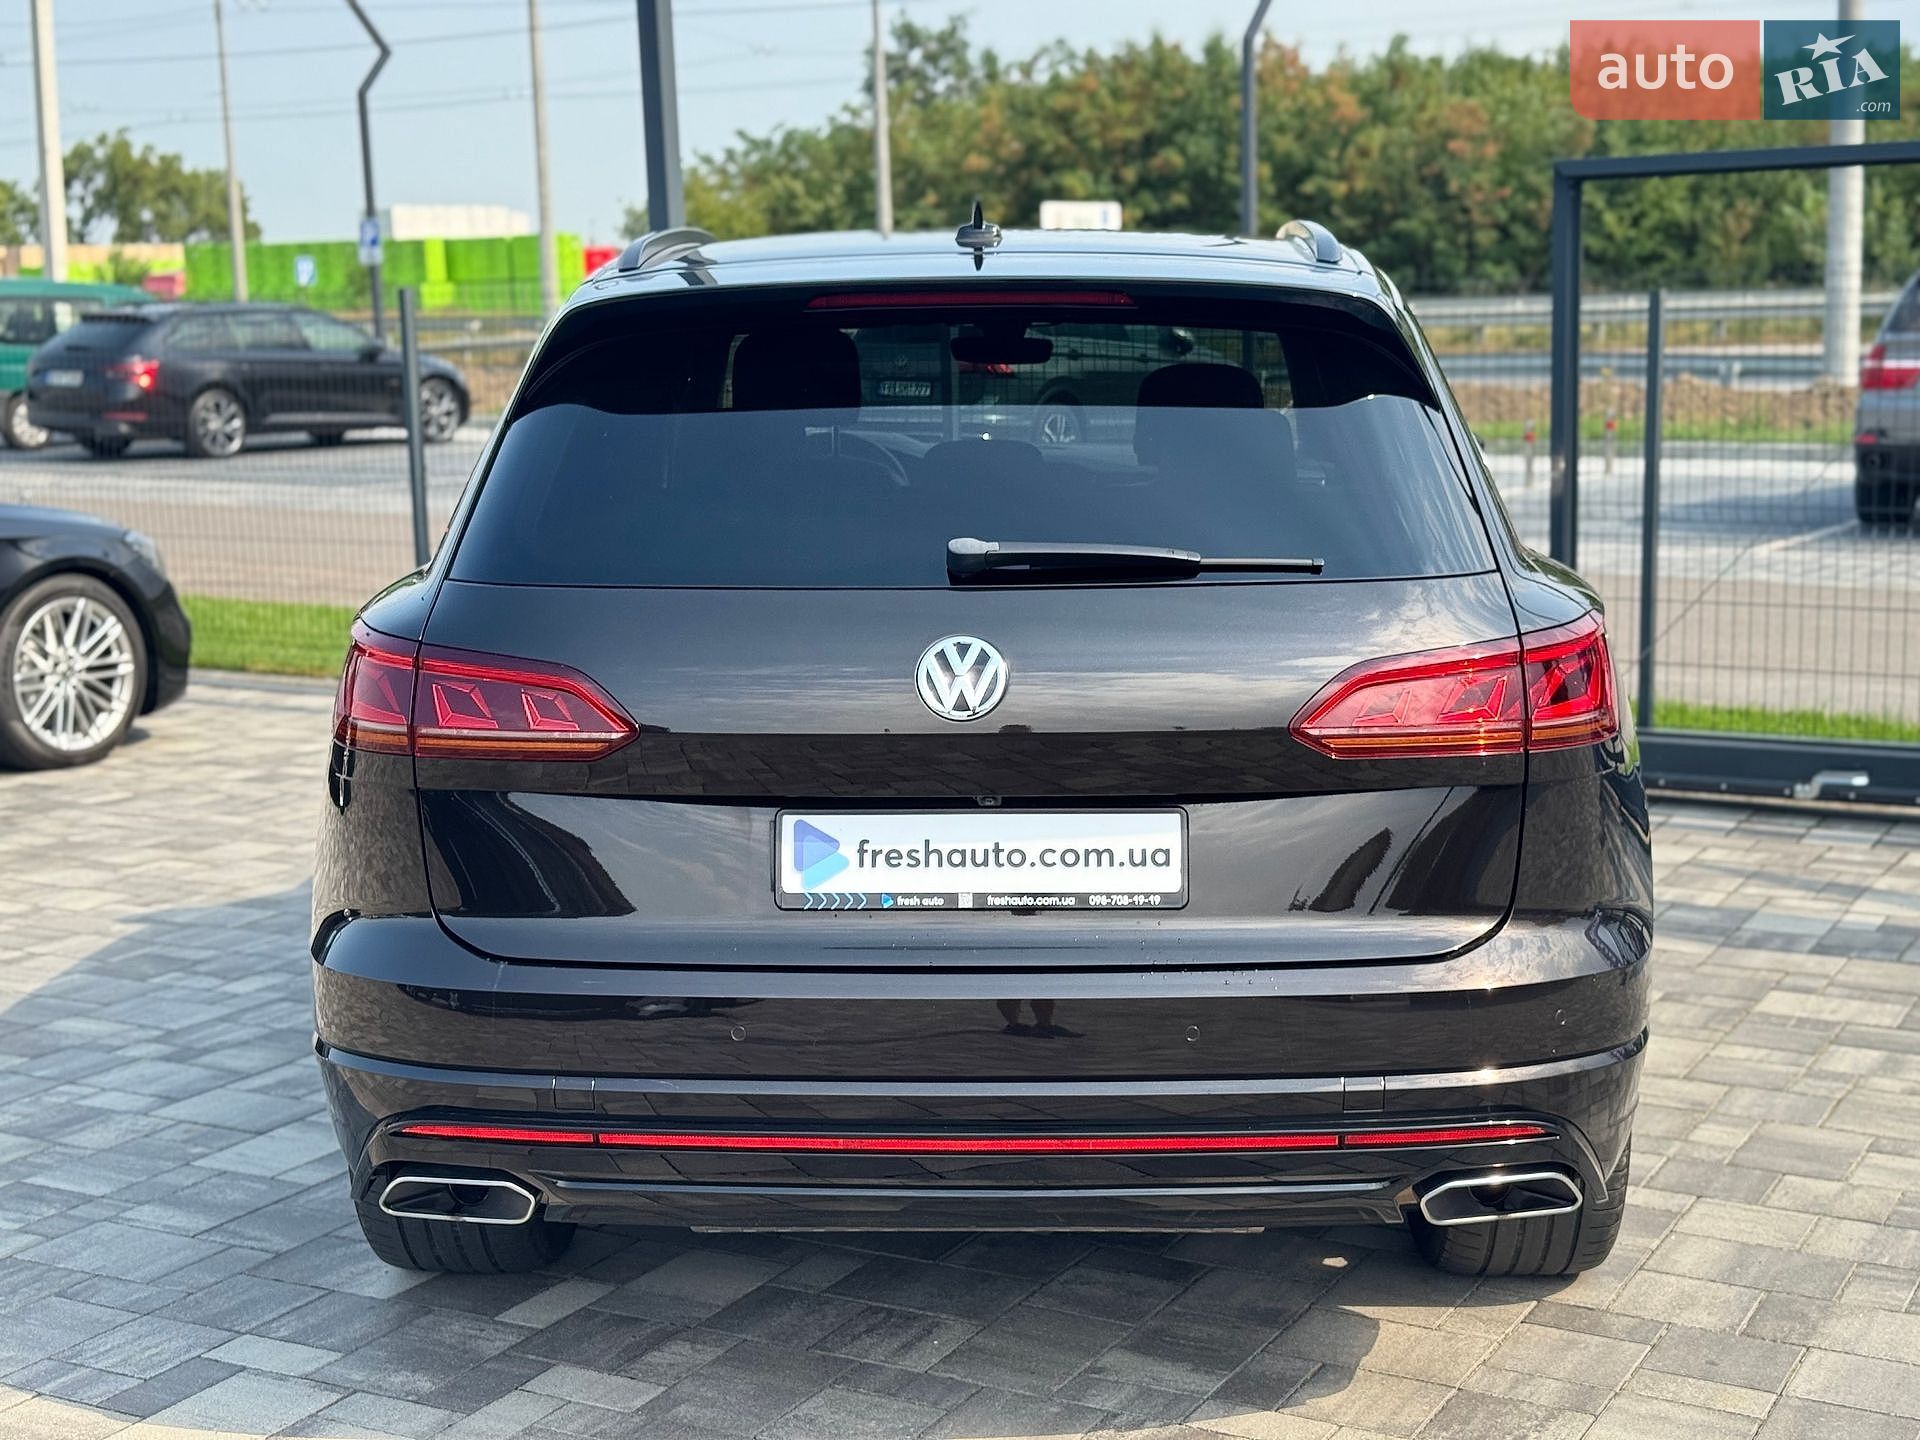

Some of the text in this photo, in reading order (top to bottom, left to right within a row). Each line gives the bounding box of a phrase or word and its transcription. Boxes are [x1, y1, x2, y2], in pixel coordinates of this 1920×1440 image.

[917, 635, 1008, 721] VW
[857, 839, 1171, 868] freshauto.com.ua
[896, 893, 945, 906] fresh auto
[986, 894, 1076, 907] freshauto.com.ua
